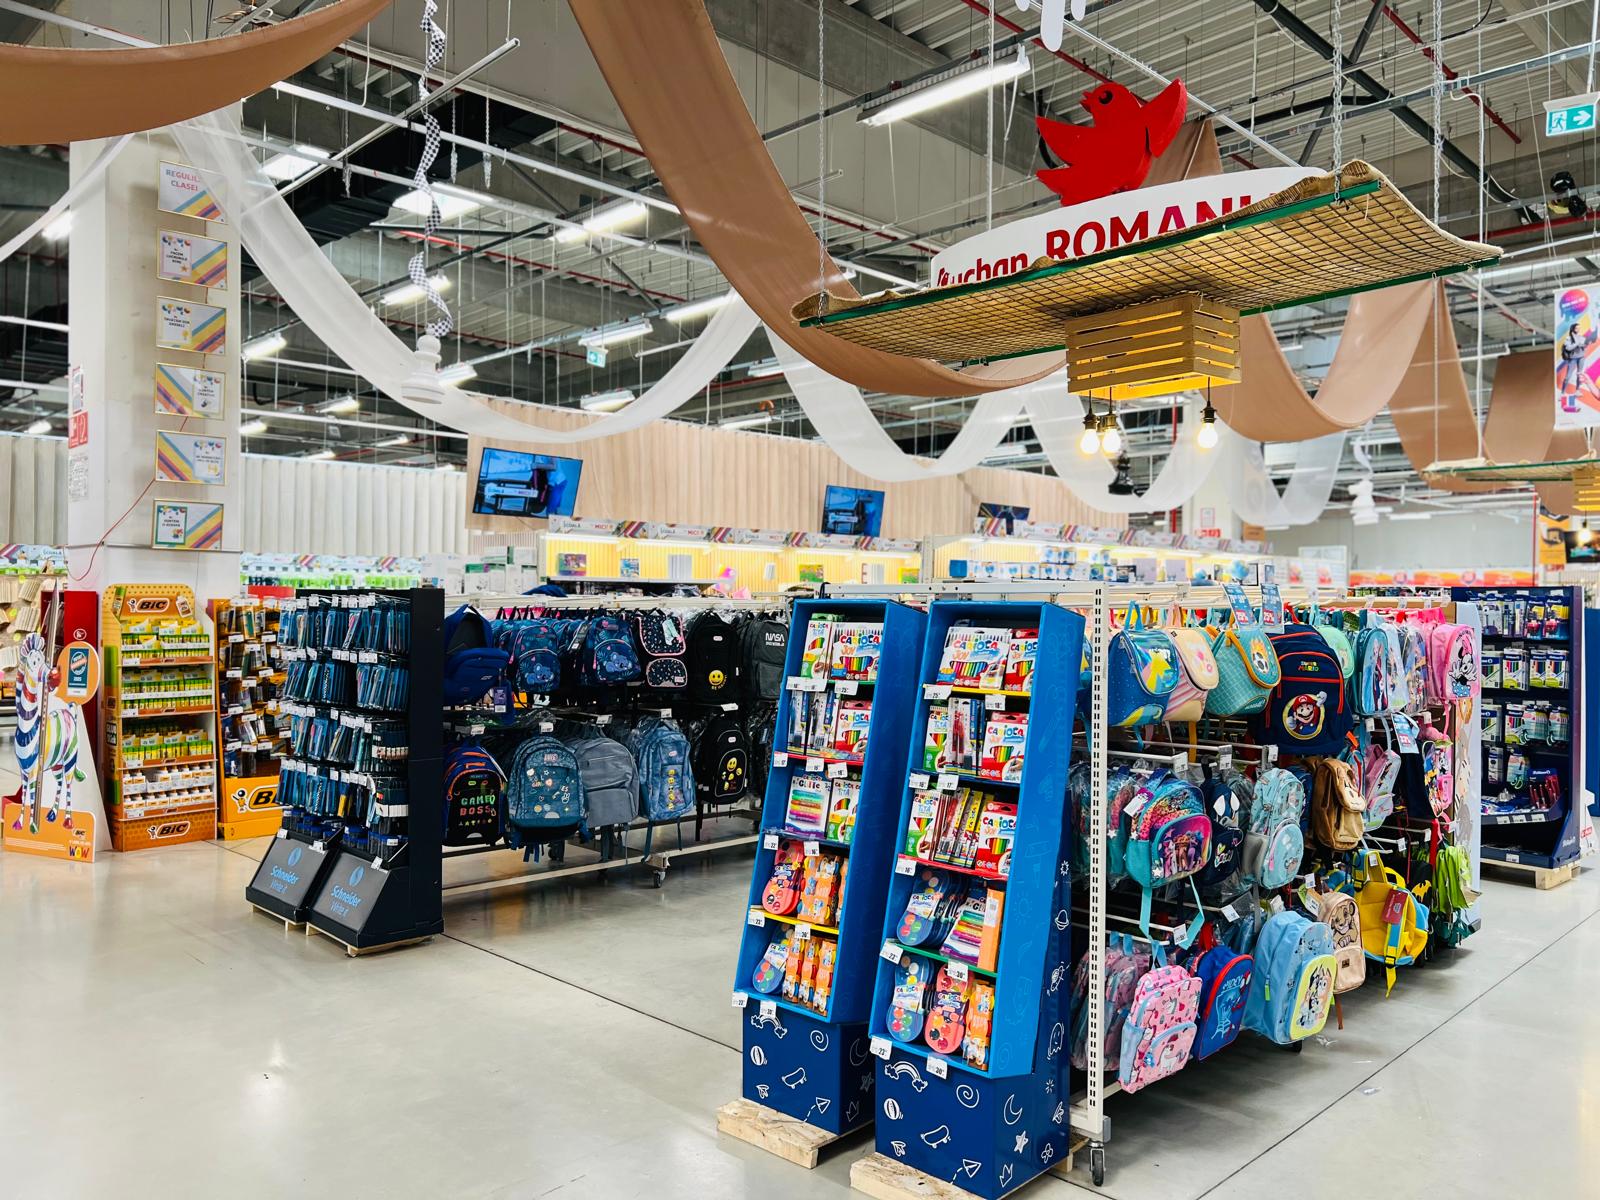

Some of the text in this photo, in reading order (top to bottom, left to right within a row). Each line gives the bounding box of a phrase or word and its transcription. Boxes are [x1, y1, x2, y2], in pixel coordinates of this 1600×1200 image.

[140, 602, 167, 610] BIC
[765, 633, 784, 642] NASA
[840, 633, 880, 646] CARIOCA
[954, 638, 998, 651] CARIOCA
[1010, 640, 1038, 652] CARIOC
[840, 712, 869, 722] CARIOCA
[988, 725, 1024, 737] CARIOCA
[460, 805, 491, 816] BOSS
[160, 823, 188, 835] BIC
[70, 846, 90, 858] WOW
[331, 885, 361, 907] Schneider
